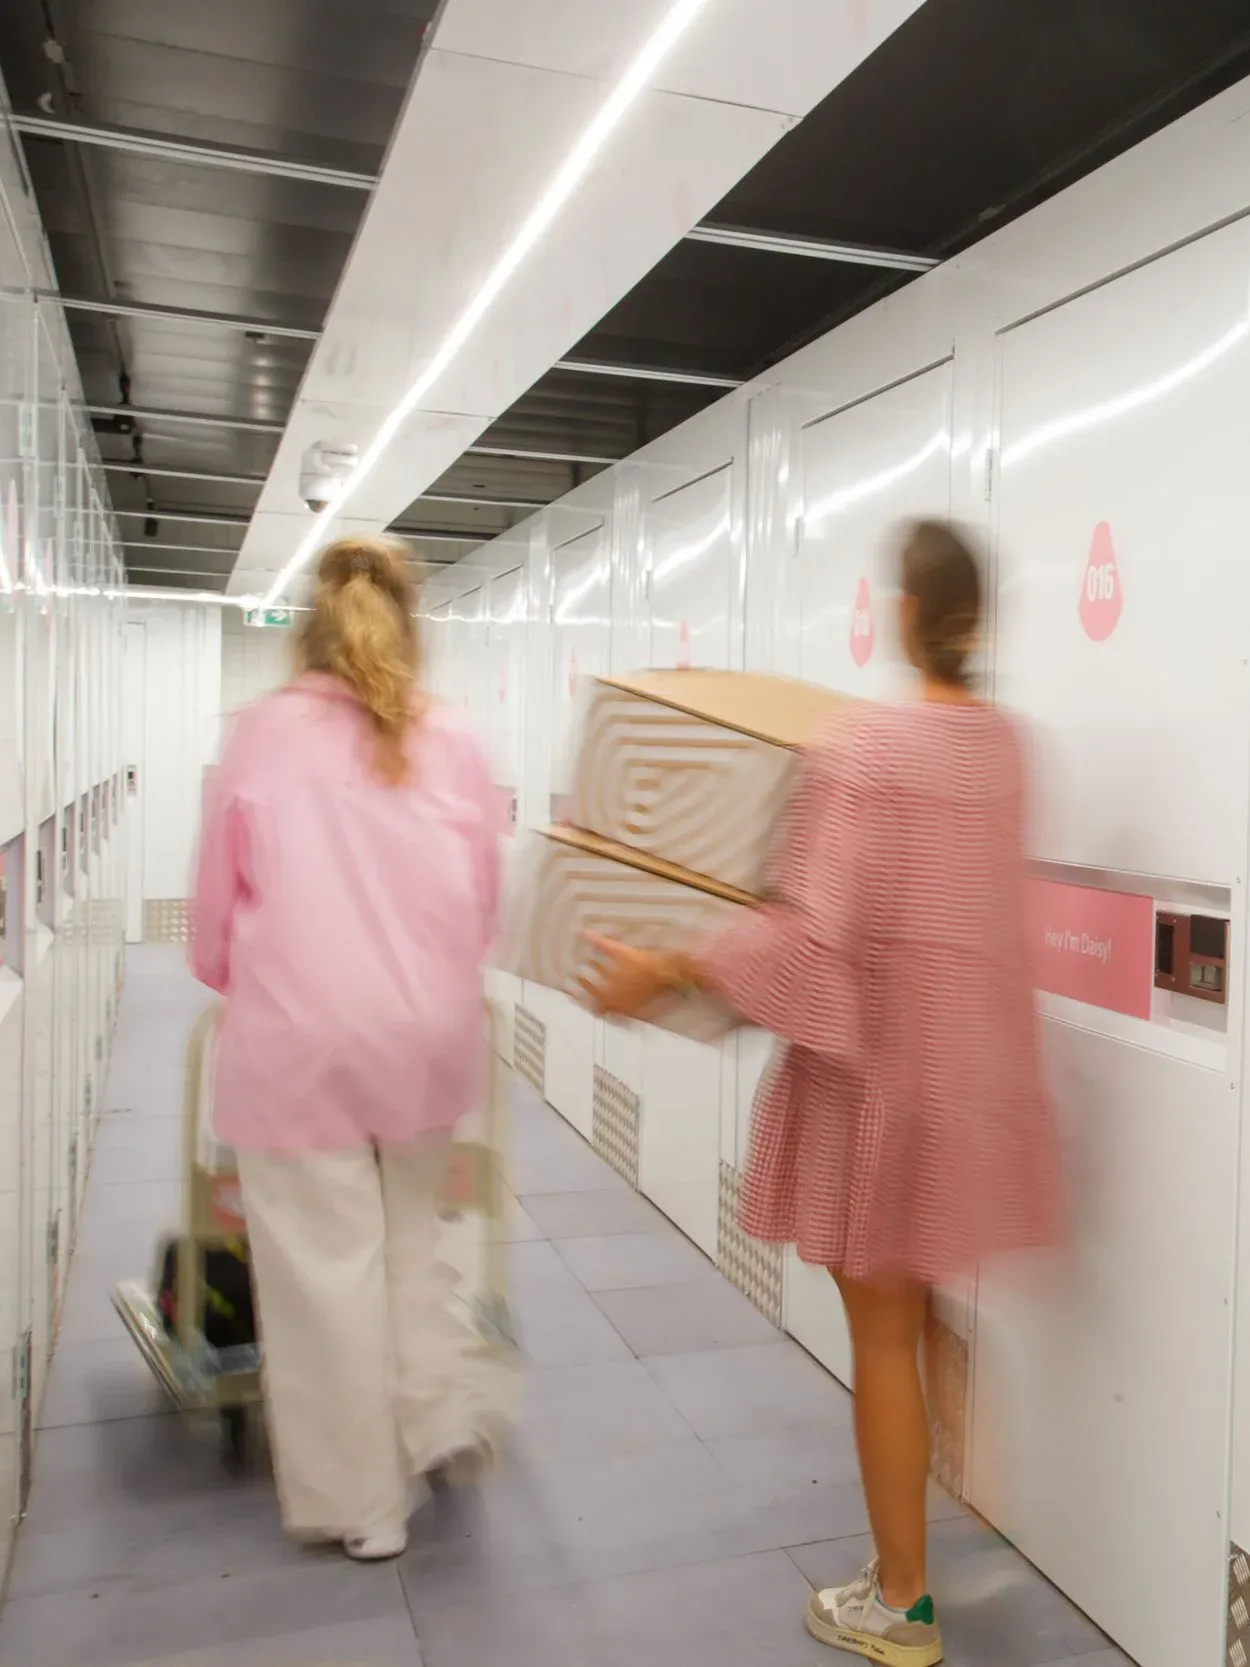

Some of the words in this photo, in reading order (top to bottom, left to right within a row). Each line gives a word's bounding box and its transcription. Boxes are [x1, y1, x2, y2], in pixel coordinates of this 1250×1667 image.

[1087, 563, 1114, 602] 016
[1045, 925, 1063, 953] Hey
[1065, 928, 1079, 952] I'm
[1081, 932, 1111, 964] Daisy!
